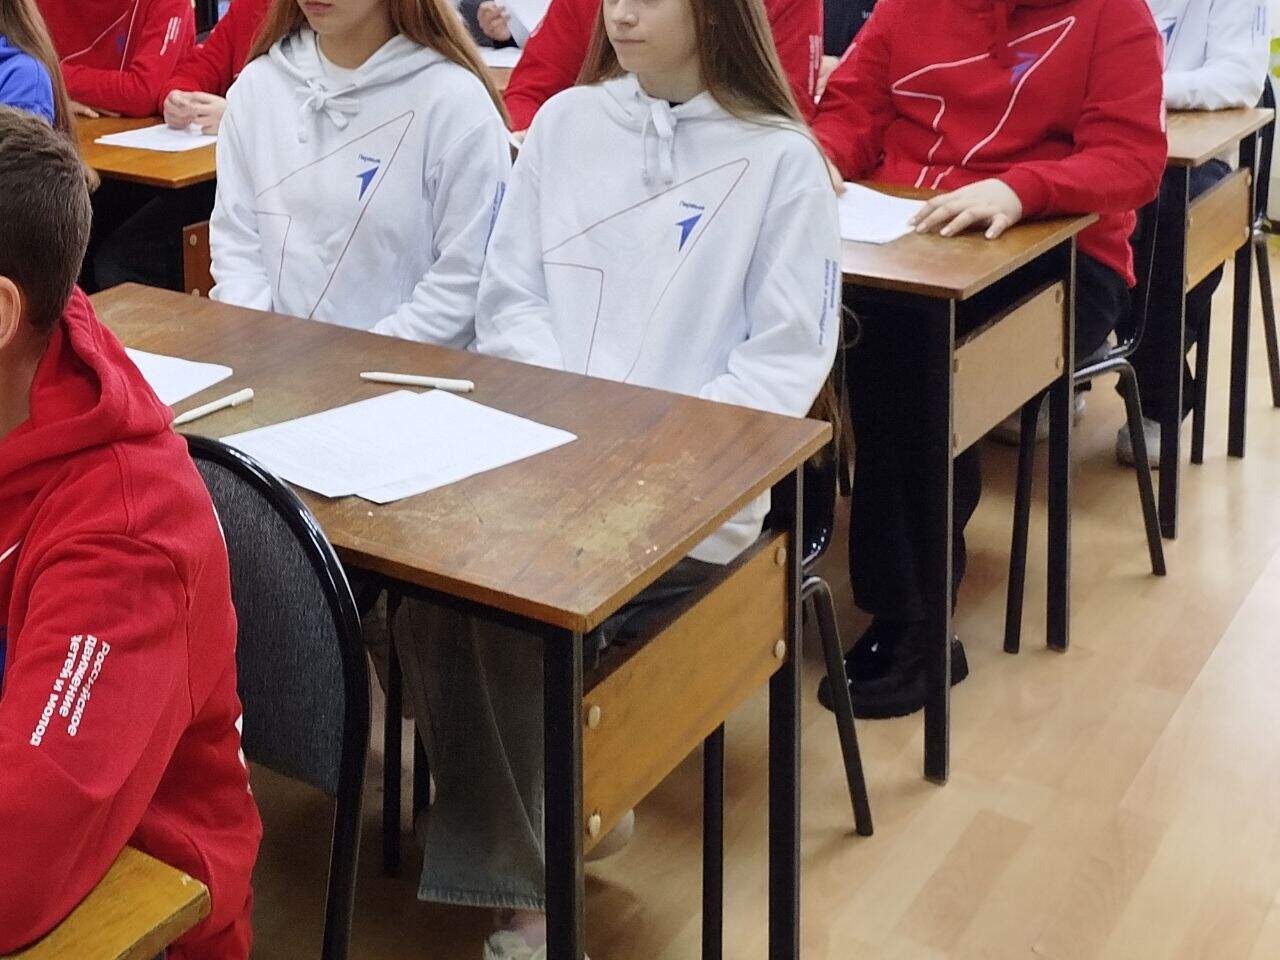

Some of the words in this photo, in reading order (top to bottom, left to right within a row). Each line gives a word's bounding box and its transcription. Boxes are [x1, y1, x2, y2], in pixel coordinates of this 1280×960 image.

[59, 634, 98, 717] движение
[60, 634, 83, 679] детей
[53, 678, 65, 692] и
[67, 640, 111, 737] Российское
[30, 693, 59, 747] молод
